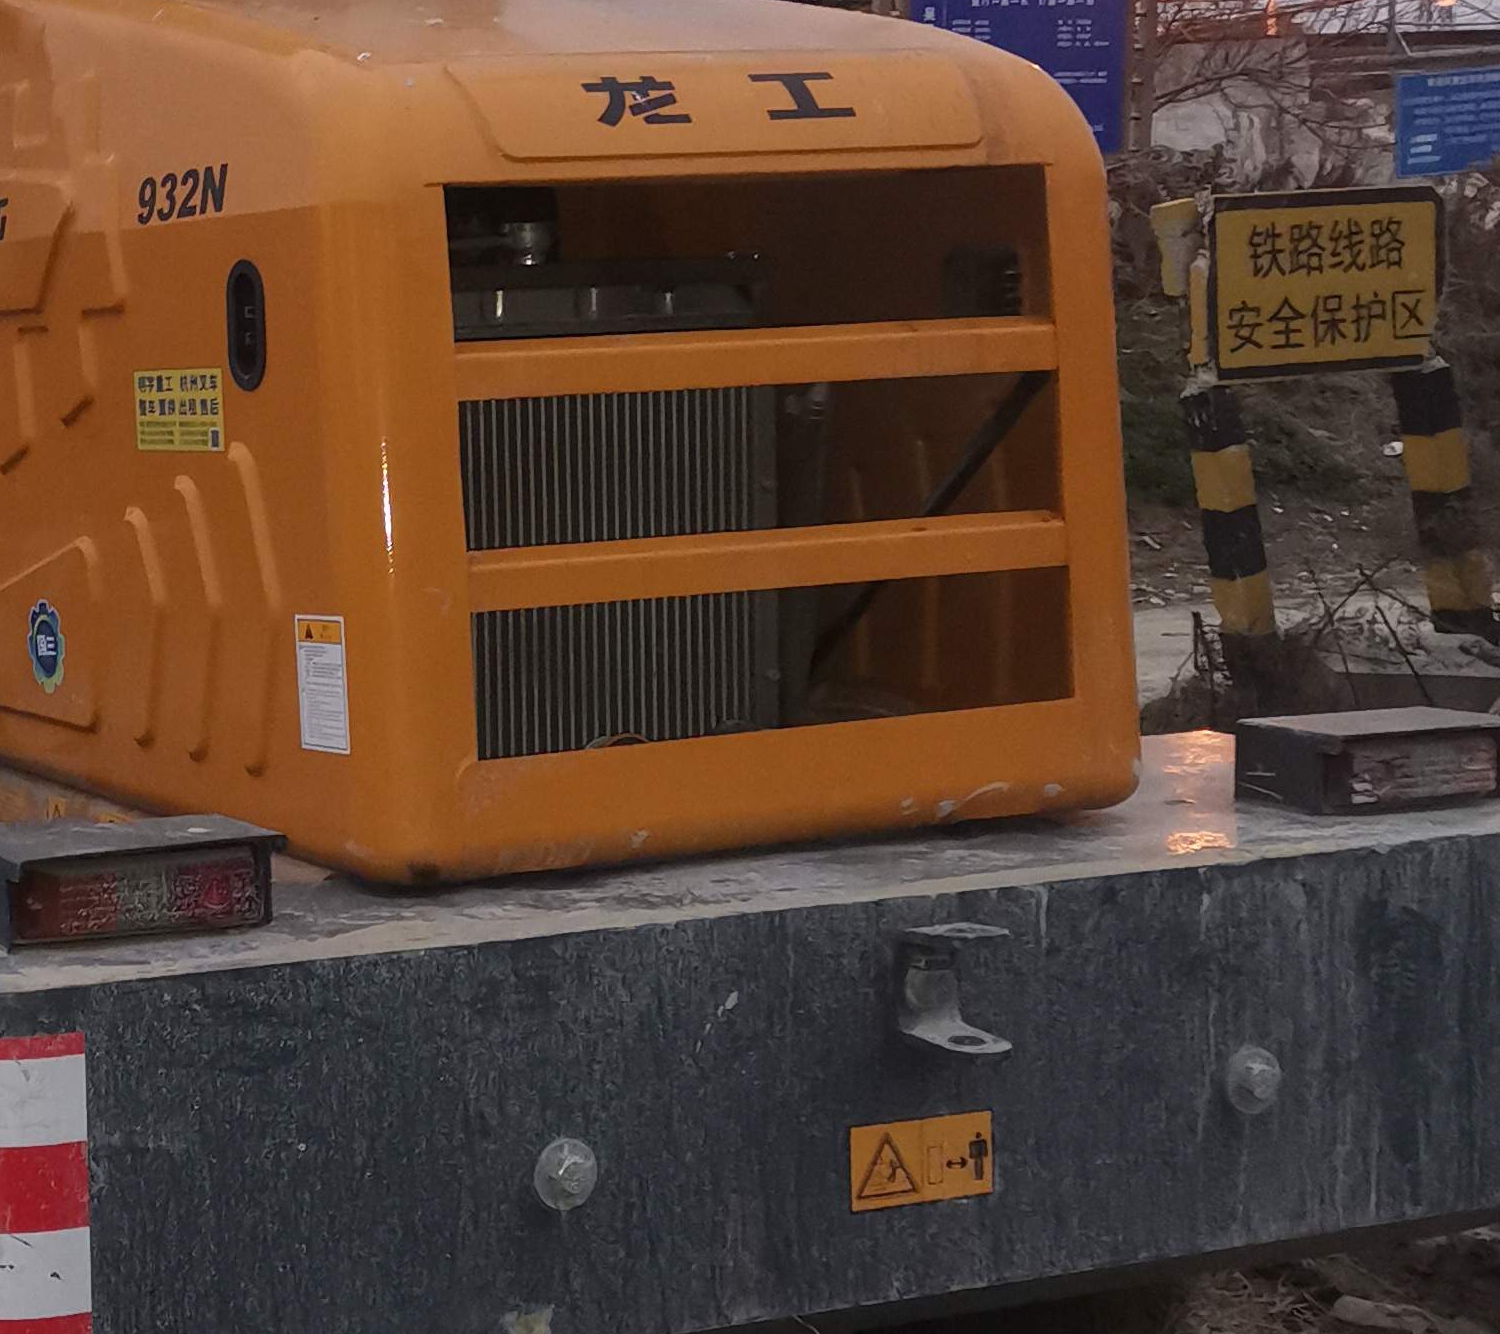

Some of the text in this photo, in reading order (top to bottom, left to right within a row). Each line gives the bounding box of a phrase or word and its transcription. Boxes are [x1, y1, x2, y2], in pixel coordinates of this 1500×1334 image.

[580, 71, 857, 127] 龙工
[137, 164, 228, 226] 932N
[1248, 218, 1405, 278] 铁路线路
[1226, 289, 1432, 353] 安全保护区
